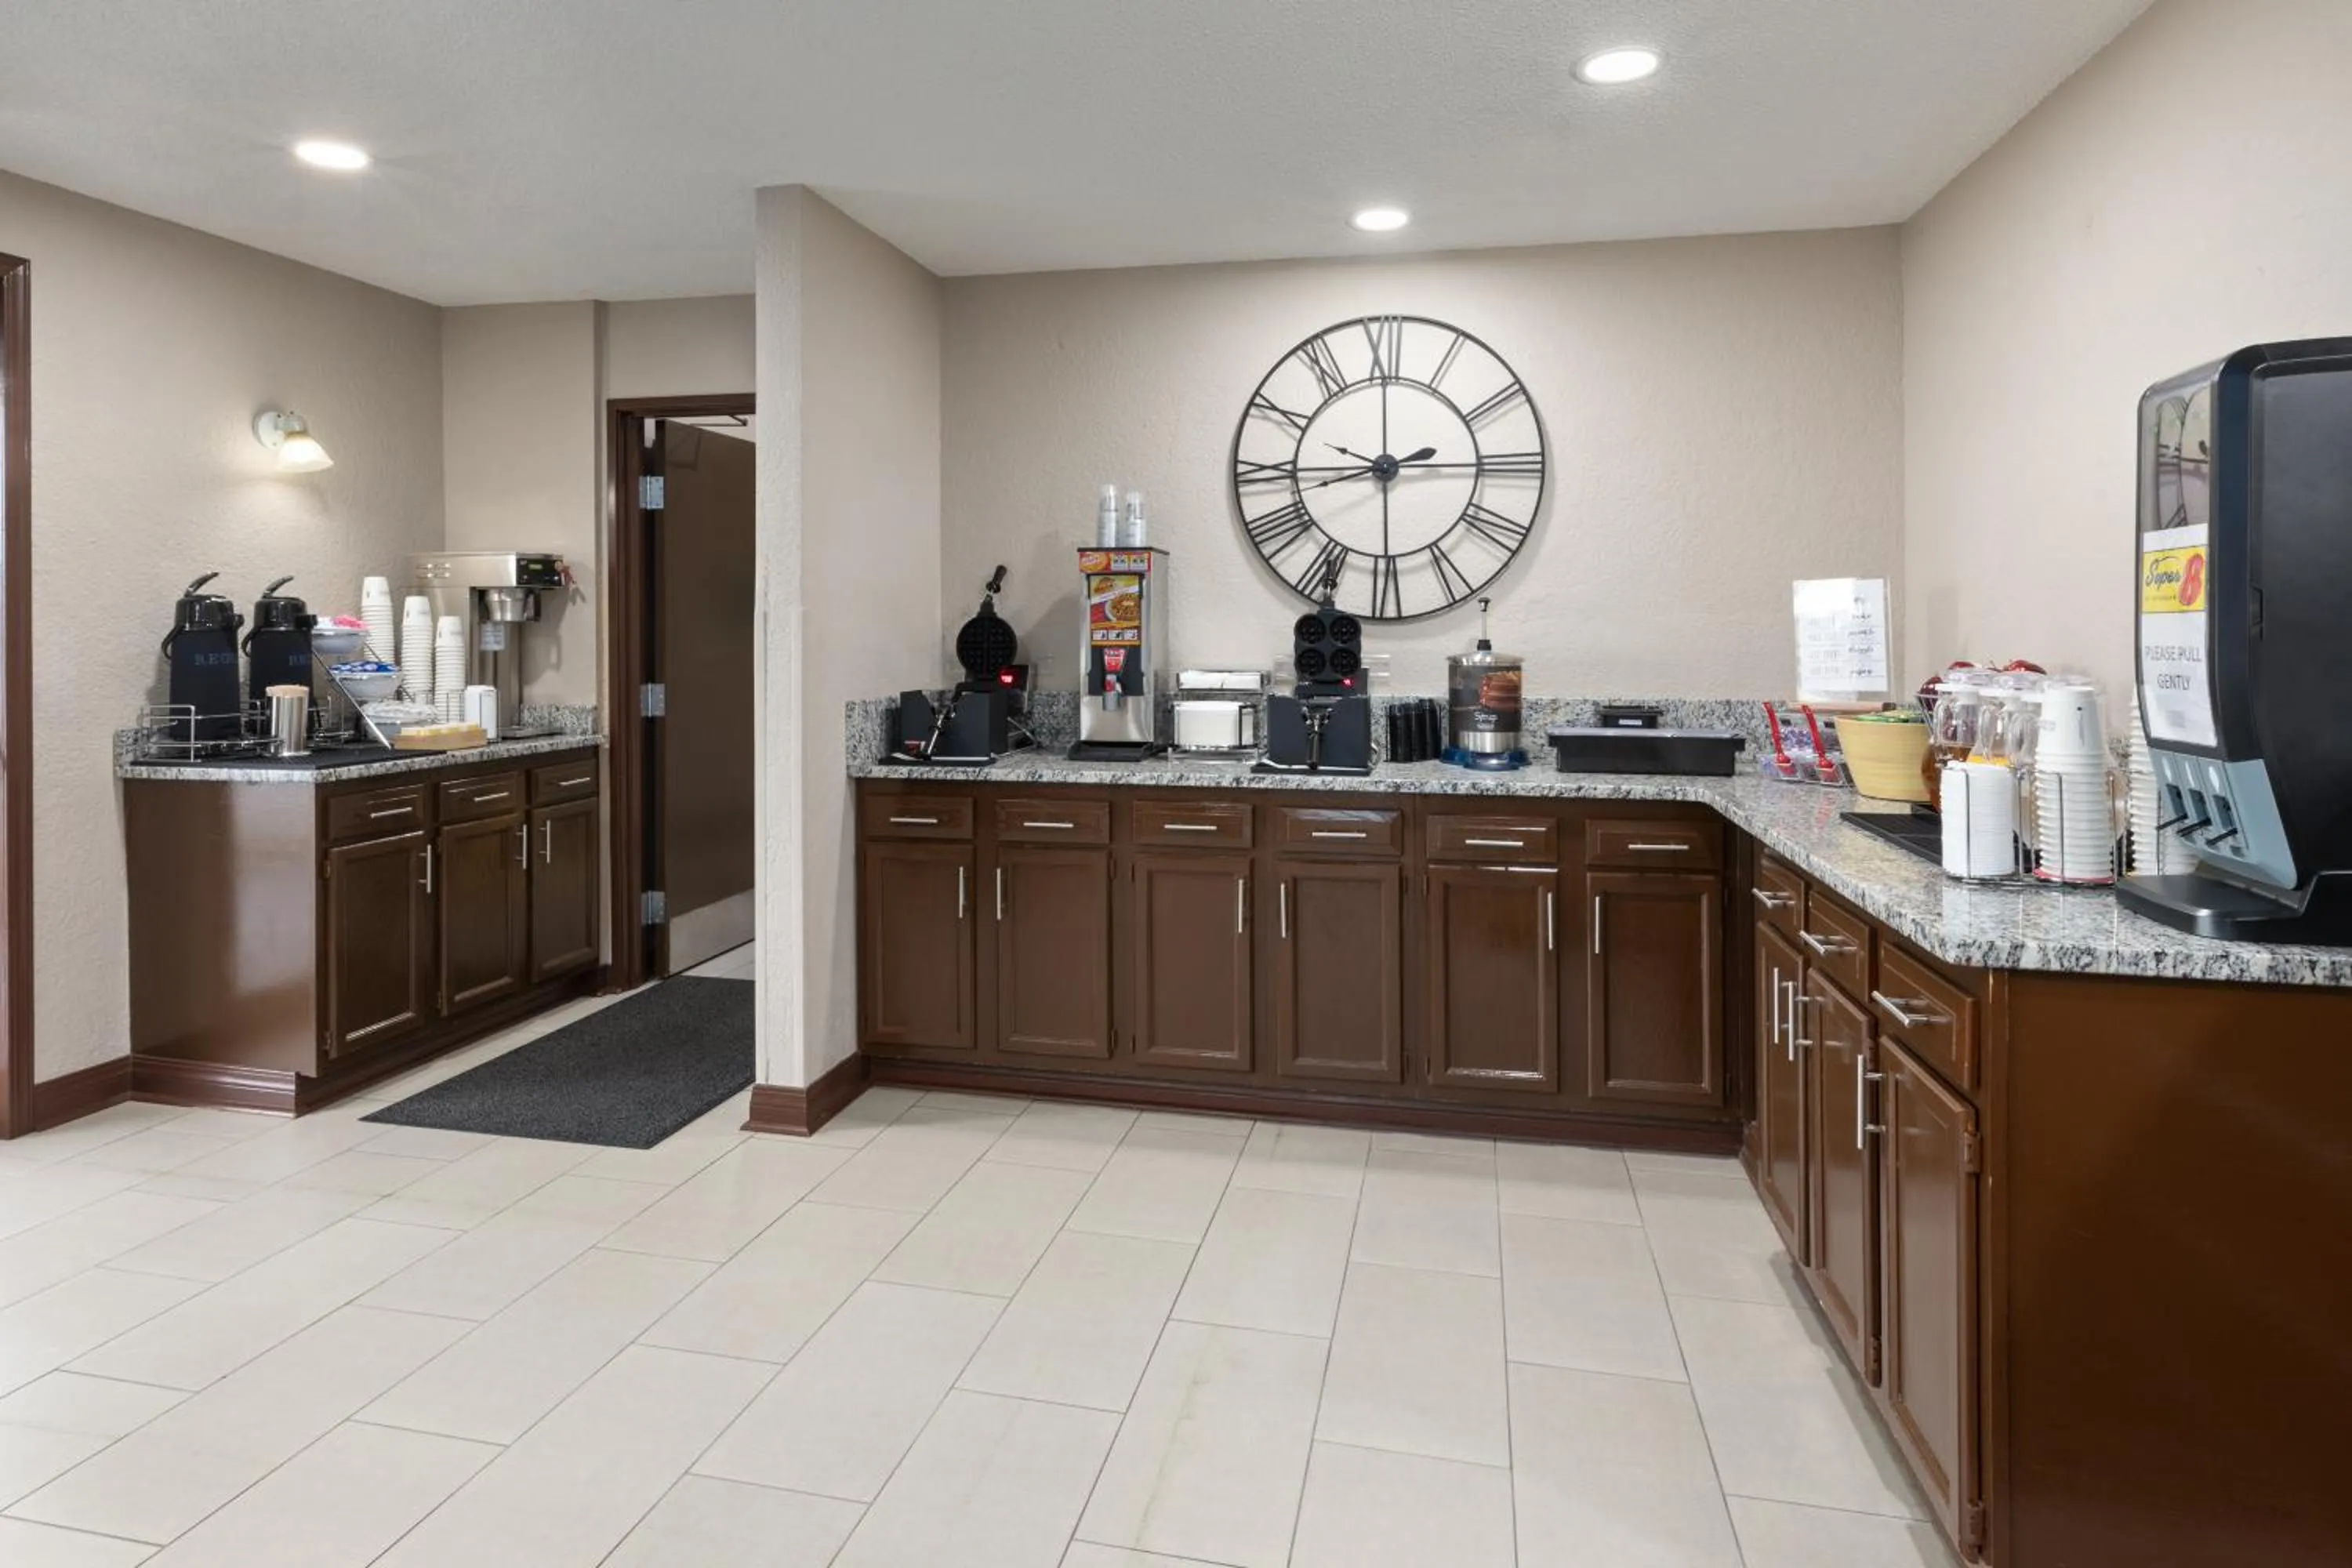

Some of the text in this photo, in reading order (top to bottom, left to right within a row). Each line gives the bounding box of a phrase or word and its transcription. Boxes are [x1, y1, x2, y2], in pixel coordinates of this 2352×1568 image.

[1363, 315, 1403, 382] XII
[2145, 554, 2204, 606] Super 8
[2144, 645, 2202, 662] PLEASE PULL
[2157, 673, 2191, 690] GENTLY
